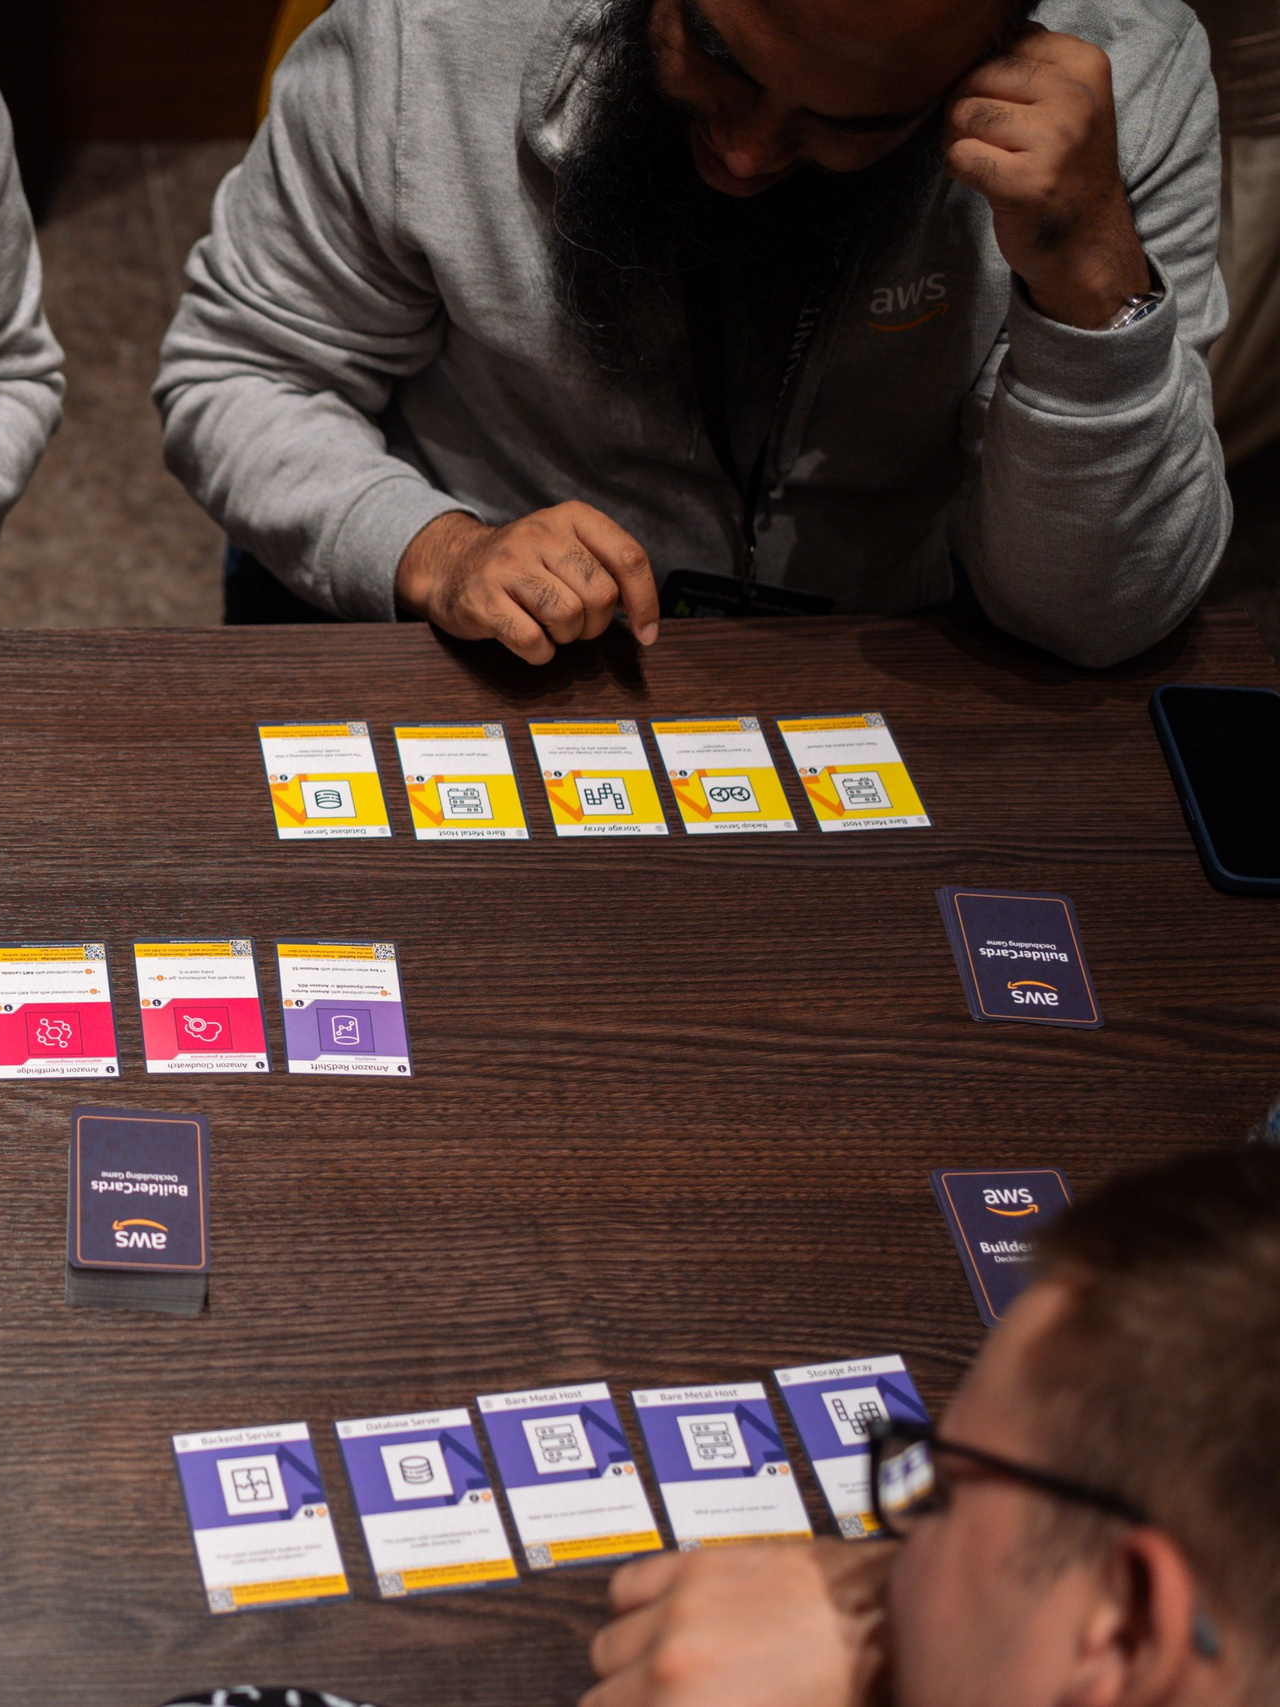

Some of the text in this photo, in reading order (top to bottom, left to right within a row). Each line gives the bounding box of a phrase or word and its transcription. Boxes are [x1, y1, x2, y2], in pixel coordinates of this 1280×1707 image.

[869, 272, 947, 315] aws
[842, 820, 862, 828] Host
[1009, 940, 1056, 950] Deckbuilding
[979, 948, 1068, 962] BuilderCards
[1011, 990, 1059, 1006] aws
[310, 1063, 389, 1072] Amazon RedShift
[101, 1171, 178, 1182] Deckbuilding Game
[91, 1180, 188, 1197] BuilderCards
[983, 1188, 1034, 1205] aws
[115, 1230, 167, 1250] aws
[807, 1363, 872, 1379] Storage Array
[505, 1390, 582, 1406] Bare Metal Host
[660, 1388, 738, 1401] Bare Metal Host
[366, 1416, 440, 1432] Database Server
[201, 1430, 281, 1446] Backend Service
